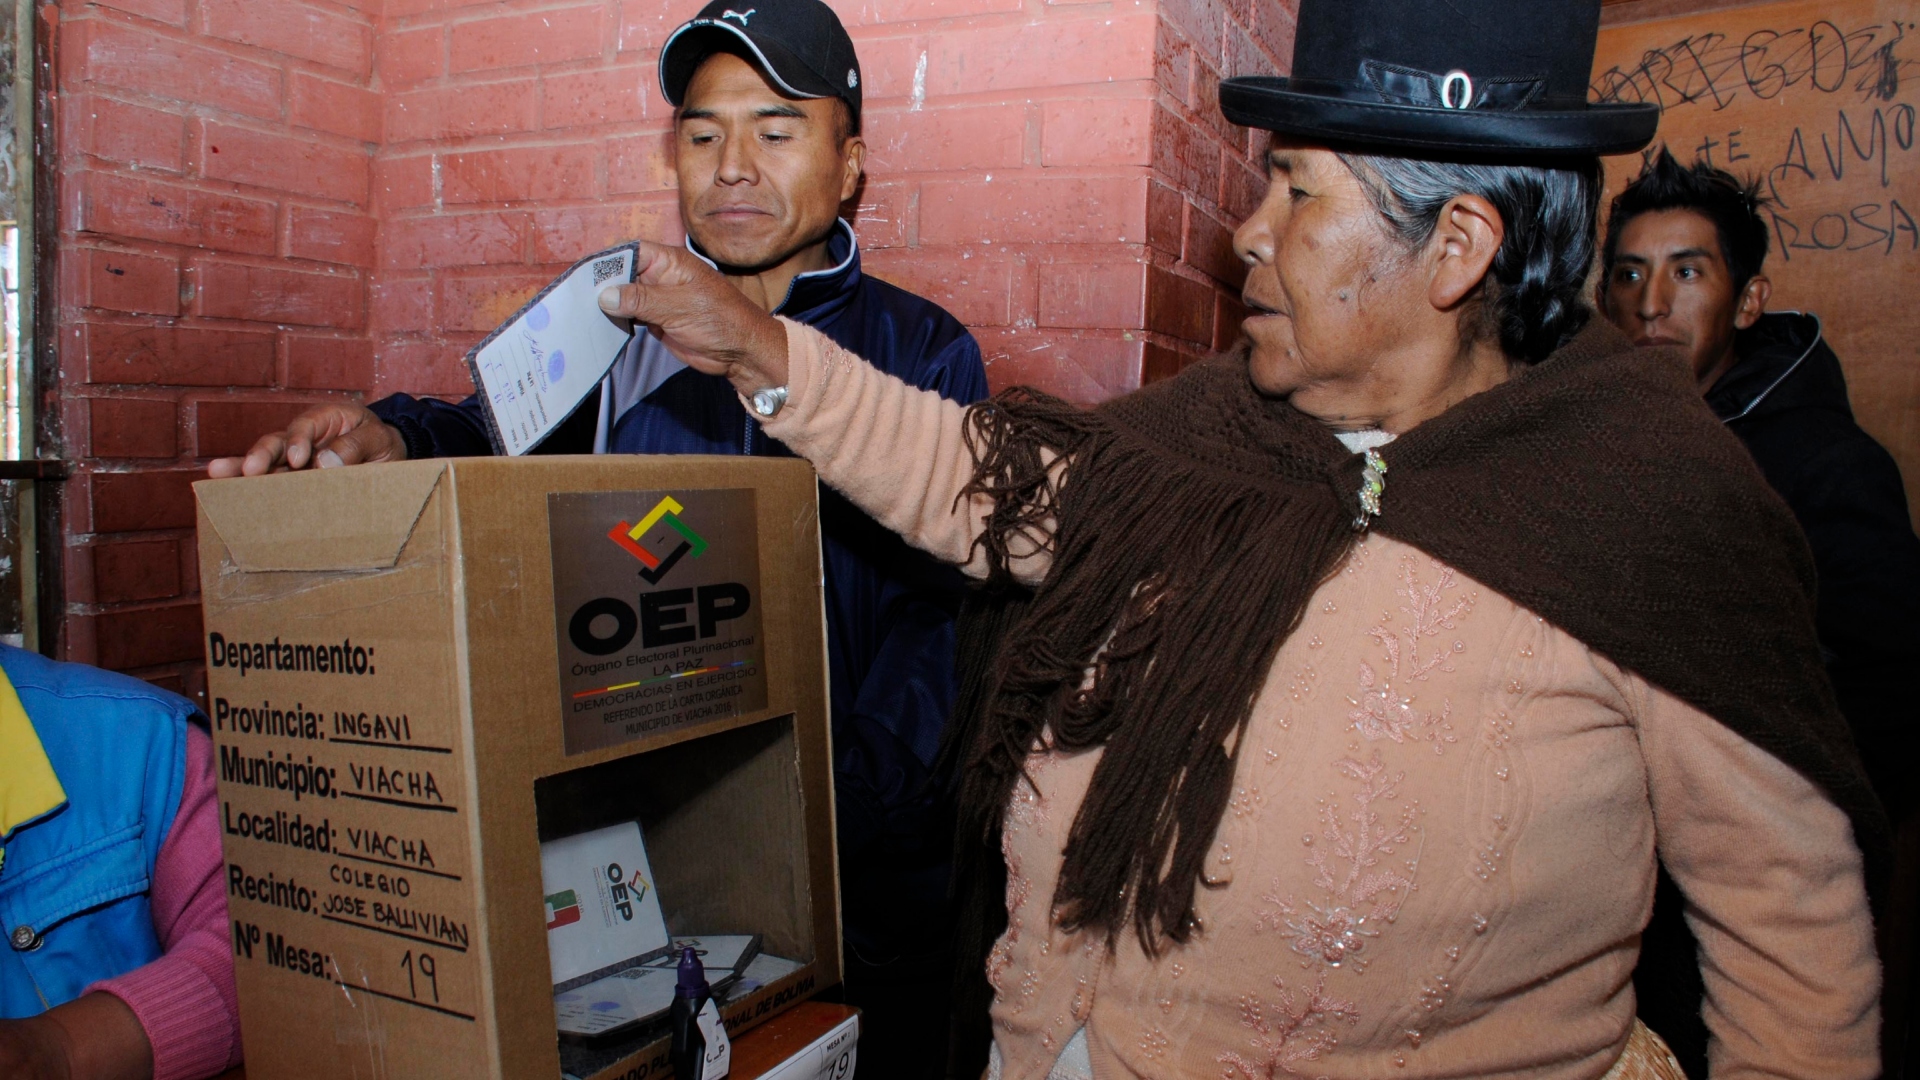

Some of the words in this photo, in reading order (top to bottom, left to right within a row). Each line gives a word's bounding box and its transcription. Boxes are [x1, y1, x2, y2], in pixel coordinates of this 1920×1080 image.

[1769, 103, 1916, 209] AMO
[1770, 199, 1919, 262] ROSA
[569, 582, 751, 656] OEP
[209, 631, 376, 677] Departamento:
[571, 659, 622, 677] Órgano
[626, 646, 679, 667] Electoral
[683, 635, 755, 656] Plurinacional
[653, 664, 673, 677] LA
[676, 657, 704, 673] PAZ
[573, 683, 673, 713] DEMOCRACIAS
[676, 679, 693, 691] EN
[696, 666, 757, 688] EJERCICIO
[603, 704, 654, 725] REFERENDO
[655, 700, 667, 713] DE
[668, 698, 679, 711] LA
[680, 692, 704, 708] CARTA
[214, 697, 325, 740] Provincia:
[333, 711, 412, 741] INGAVI
[625, 717, 671, 735] MUNICIPIO
[672, 712, 683, 724] DE
[684, 706, 713, 722] VIACHA
[714, 702, 733, 715] 2016
[220, 744, 338, 801] Municipio:
[349, 762, 443, 802] VIACHA
[223, 801, 338, 855] Localidad:
[347, 827, 436, 868] VIACHA
[228, 863, 319, 915] Recinto:
[322, 895, 368, 919] JOSE
[330, 864, 411, 897] COLEGIO
[607, 862, 634, 922] OEP
[266, 931, 332, 980] Mesa:
[401, 950, 440, 1003] 19
[755, 995, 773, 1018] DE
[772, 974, 815, 1009] BOLIVIA
[826, 1037, 841, 1053] MESA
[828, 1051, 849, 1080] 19
